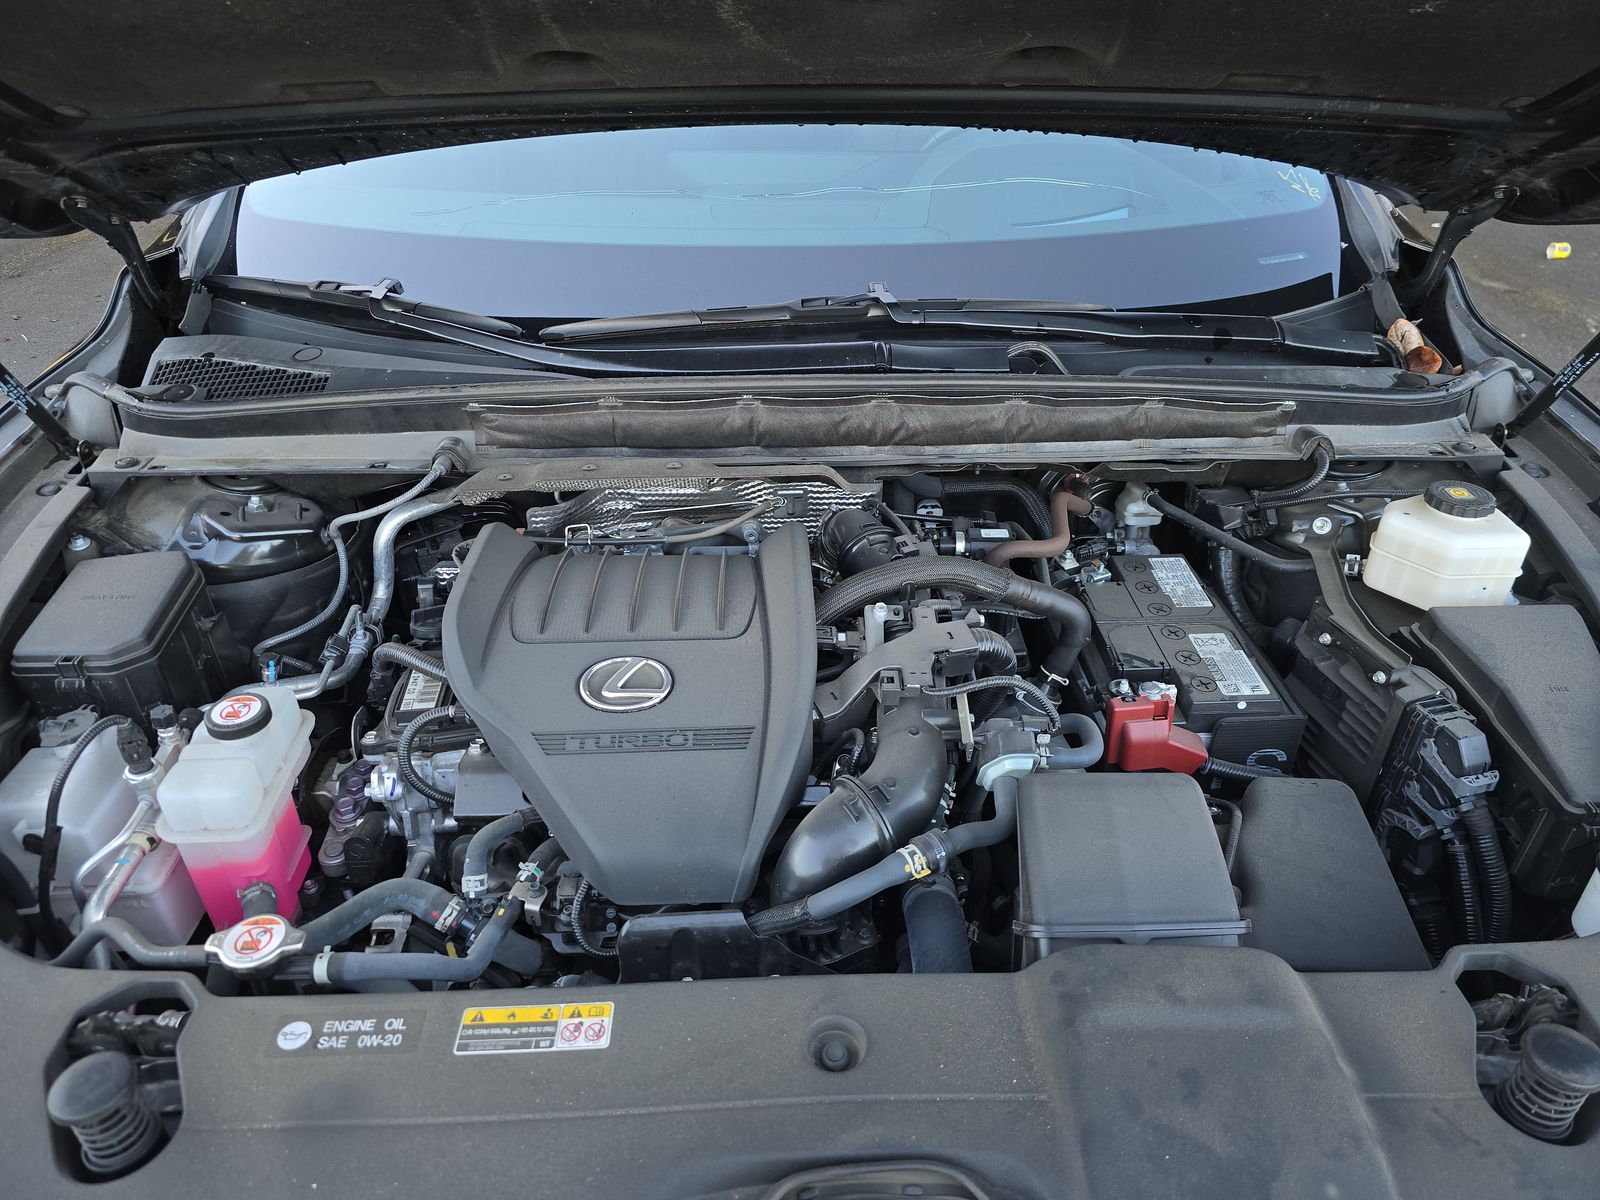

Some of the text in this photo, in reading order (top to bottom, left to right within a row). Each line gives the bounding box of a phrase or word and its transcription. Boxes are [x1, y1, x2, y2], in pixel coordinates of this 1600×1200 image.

[570, 732, 689, 749] TURBO
[322, 1017, 407, 1033] ENGINE OIL
[316, 1033, 403, 1049] SAE 0W-20
